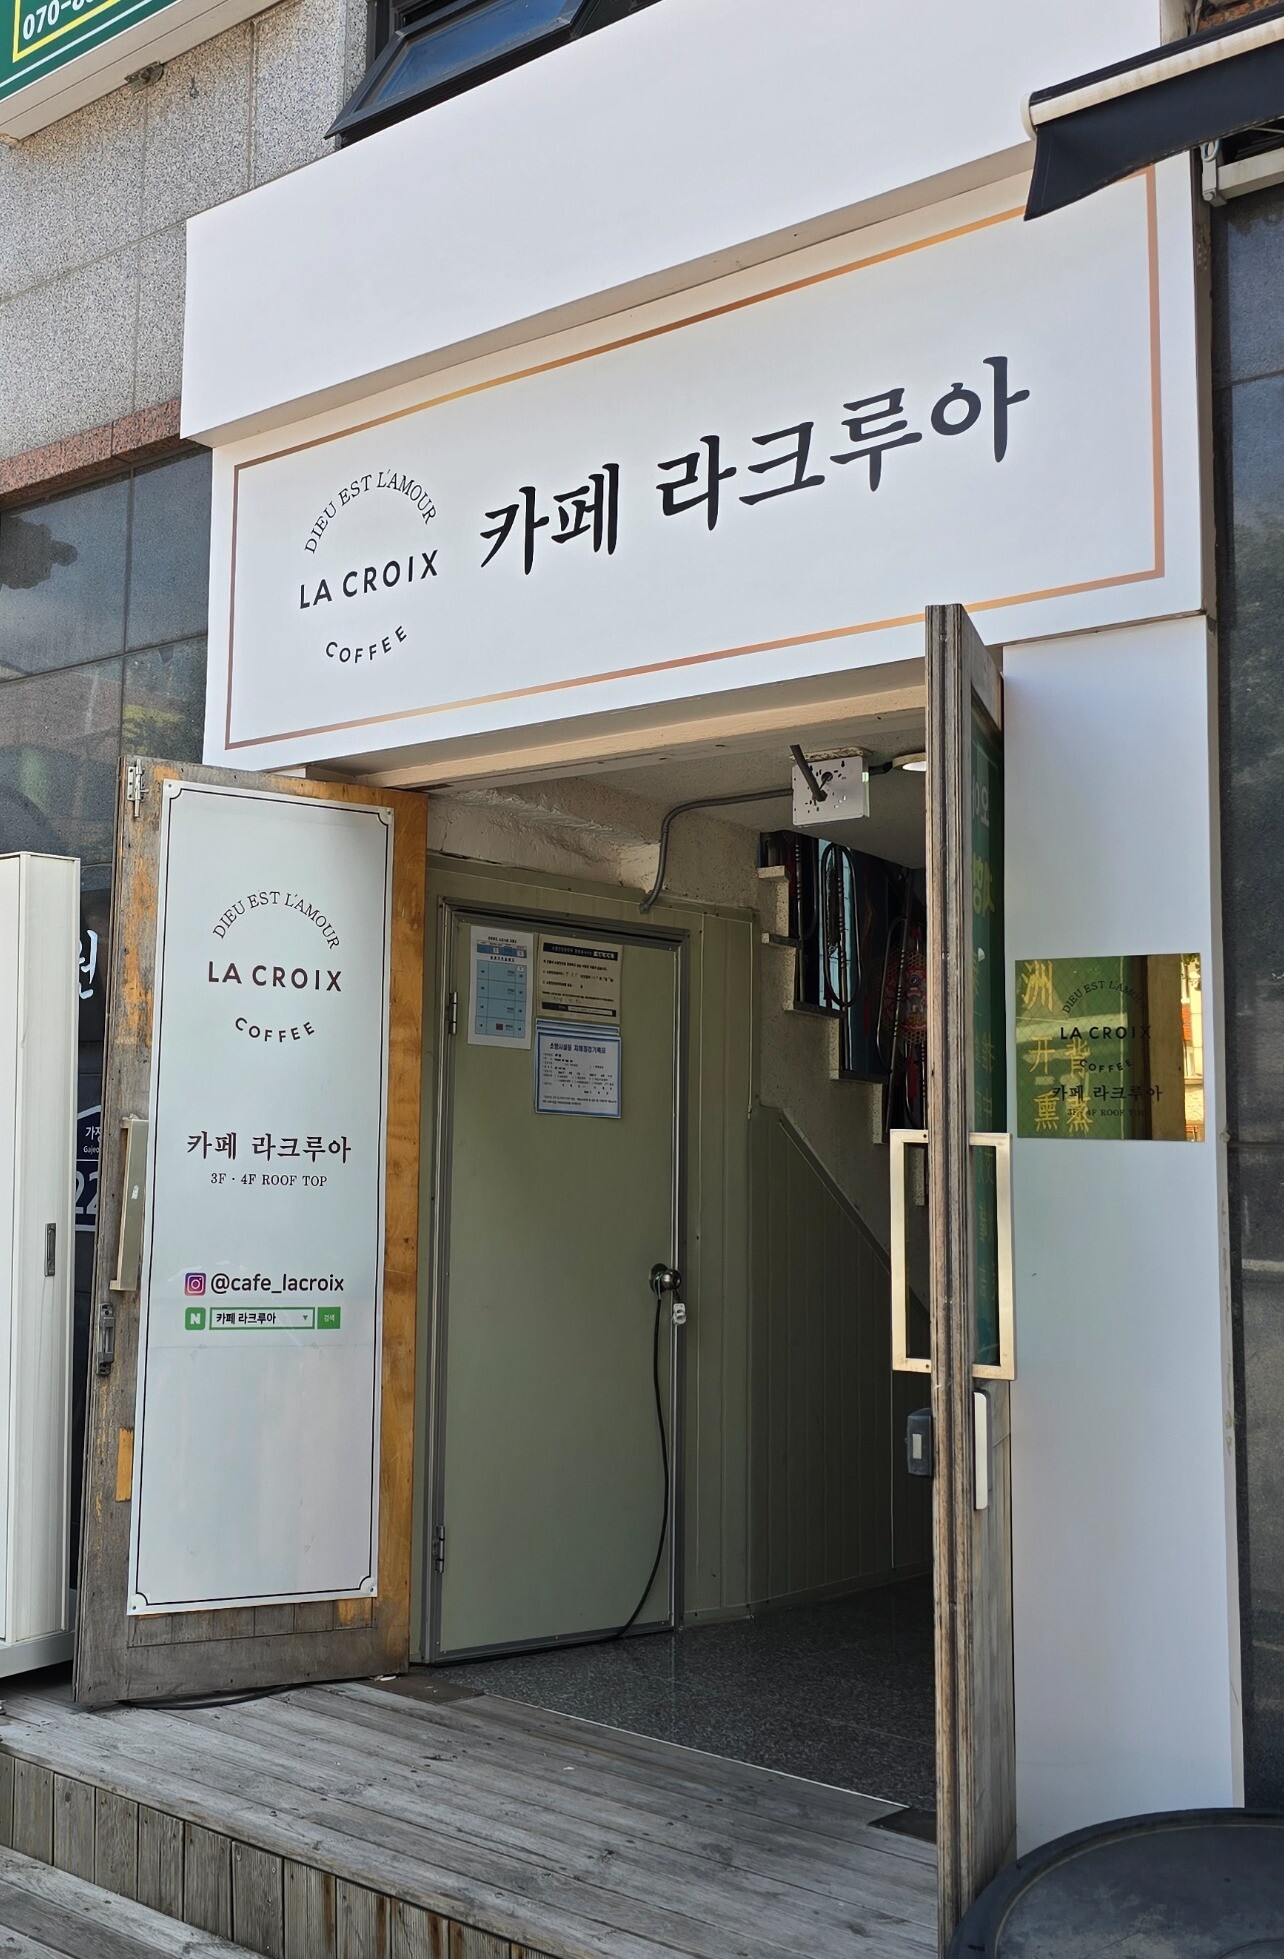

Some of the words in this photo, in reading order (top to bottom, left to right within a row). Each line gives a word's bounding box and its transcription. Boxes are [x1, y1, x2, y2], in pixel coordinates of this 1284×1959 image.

[23, 0, 94, 40] 070-
[480, 463, 620, 575] 카페
[656, 356, 1030, 531] 라크루아
[304, 500, 337, 554] DIEU
[337, 474, 373, 507] EST
[376, 469, 437, 525] L'AMOUR
[300, 579, 333, 609] LA
[342, 549, 438, 598] CROIX
[325, 625, 407, 664] COFFEE
[212, 900, 246, 939] DIEU
[247, 891, 280, 909] EST
[285, 893, 340, 950] L'AMOUR
[208, 961, 242, 984] LA
[252, 965, 342, 992] CROIX
[1062, 989, 1083, 1013] DIEU
[1084, 980, 1106, 994] EST
[235, 1017, 315, 1043] COFFEE
[1060, 1026, 1082, 1040] LA
[1089, 1026, 1152, 1040] CROIX
[1080, 1059, 1133, 1073] COFFEE
[1052, 1085, 1084, 1101] 카페
[1093, 1085, 1163, 1102] 라크루아
[187, 1131, 237, 1160] 카페
[252, 1133, 352, 1164] 라크루아
[211, 1172, 227, 1184] 3F
[240, 1173, 257, 1185] 4F
[261, 1174, 298, 1186] ROOF
[302, 1175, 328, 1187] TOP
[211, 1273, 344, 1294] @cafe_lacroix
[216, 1313, 236, 1325] 카페
[238, 1313, 276, 1325] 라크루아
